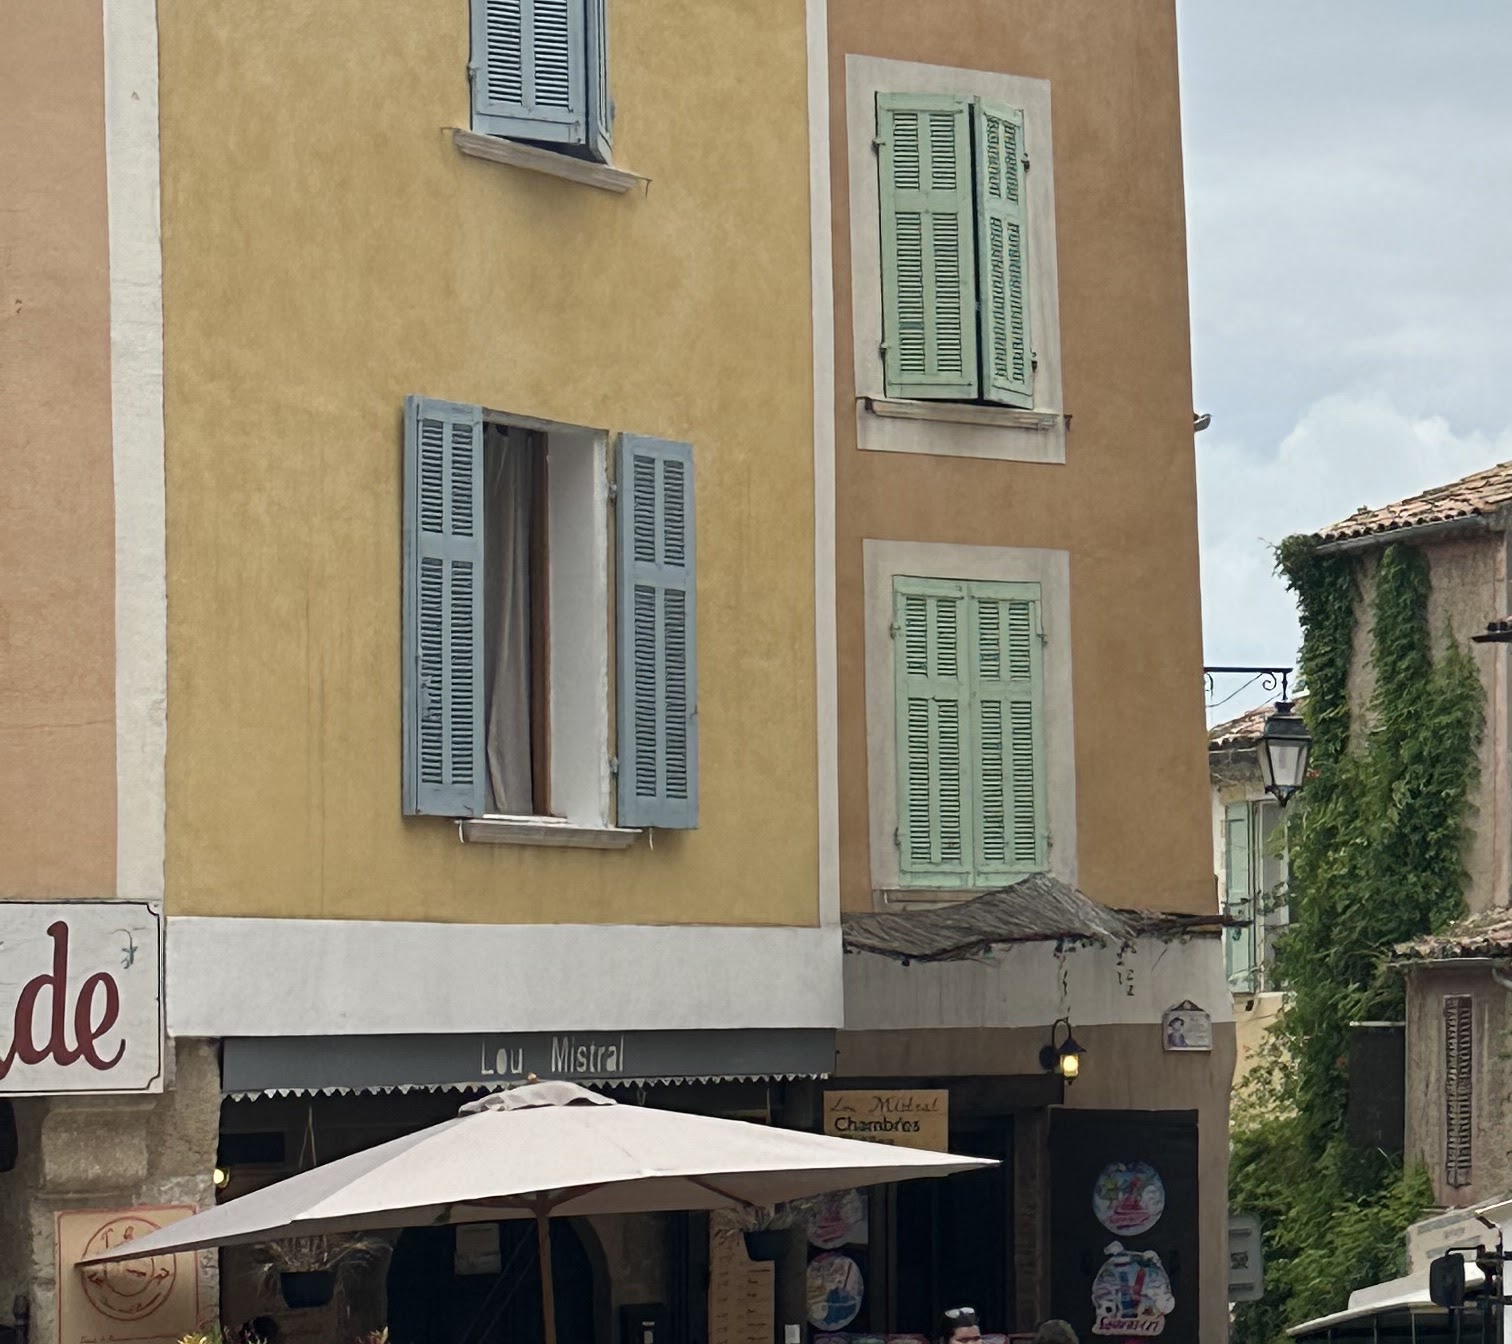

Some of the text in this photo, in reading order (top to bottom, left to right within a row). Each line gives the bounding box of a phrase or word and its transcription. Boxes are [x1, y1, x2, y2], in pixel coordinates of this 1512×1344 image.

[0, 921, 126, 1080] de
[481, 1034, 624, 1075] Lou Mistral
